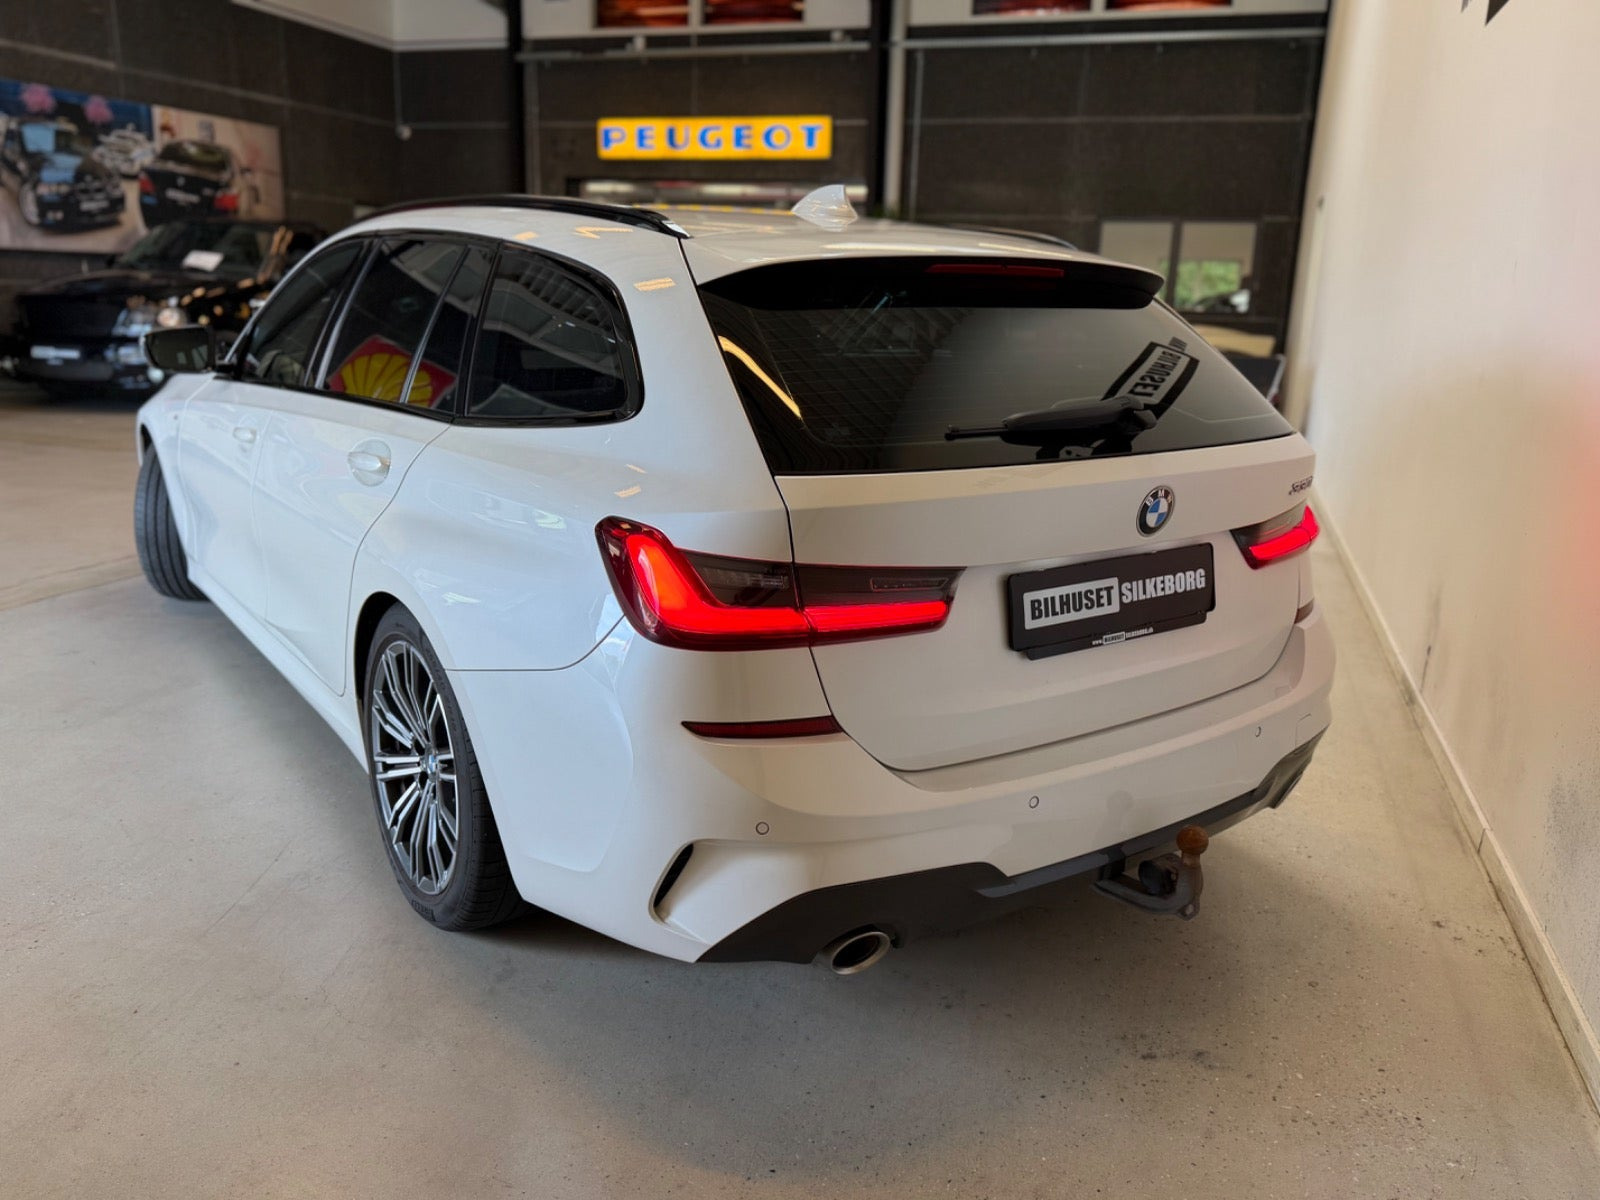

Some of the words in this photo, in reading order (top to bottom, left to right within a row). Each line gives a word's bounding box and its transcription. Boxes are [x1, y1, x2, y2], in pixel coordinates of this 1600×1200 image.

[602, 124, 824, 151] PEUGEOT
[1030, 585, 1115, 621] BILHUSET
[1120, 568, 1206, 604] SILKEBORG
